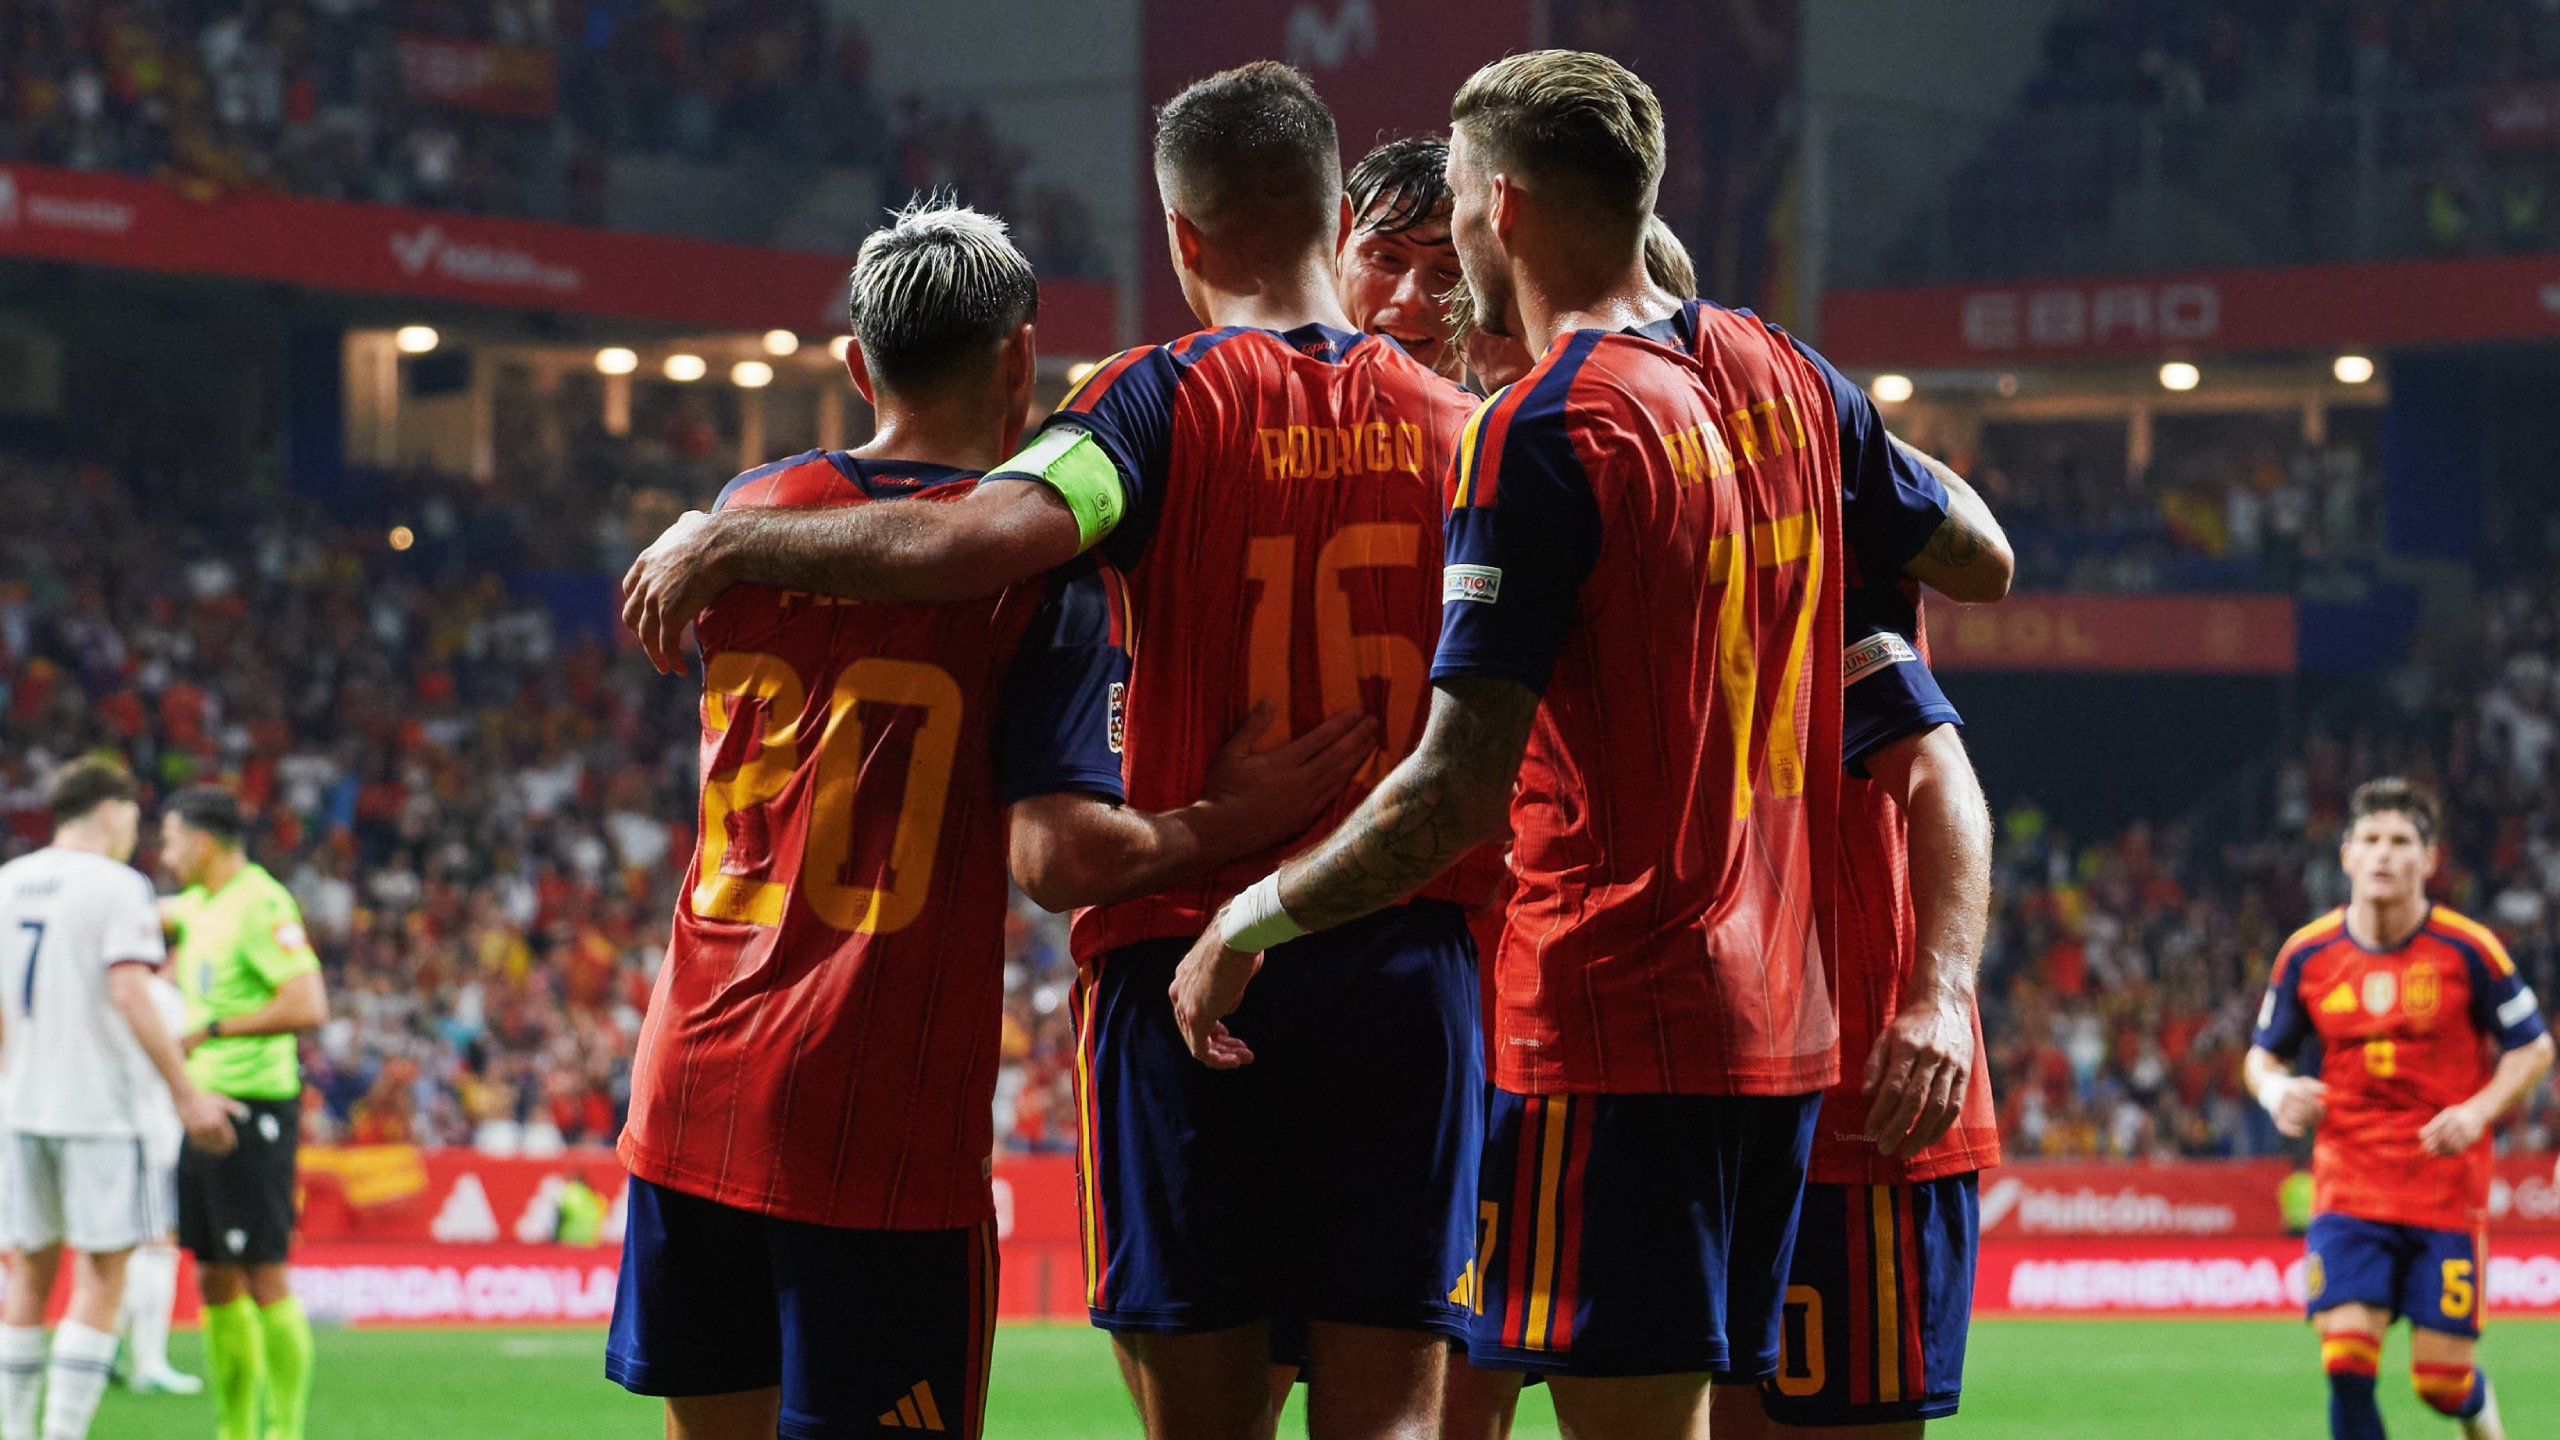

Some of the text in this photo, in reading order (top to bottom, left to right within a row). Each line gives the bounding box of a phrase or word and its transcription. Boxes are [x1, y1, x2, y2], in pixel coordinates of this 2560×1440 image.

[1258, 422, 1424, 480] RODRIGO
[1663, 393, 1806, 488] ROBRTO
[1246, 522, 1425, 789] 16
[1709, 509, 1820, 820] 17
[692, 652, 963, 934] 20
[19, 919, 46, 1018] 7
[2009, 1257, 2282, 1308] MERIENDA
[2440, 1258, 2473, 1319] 5
